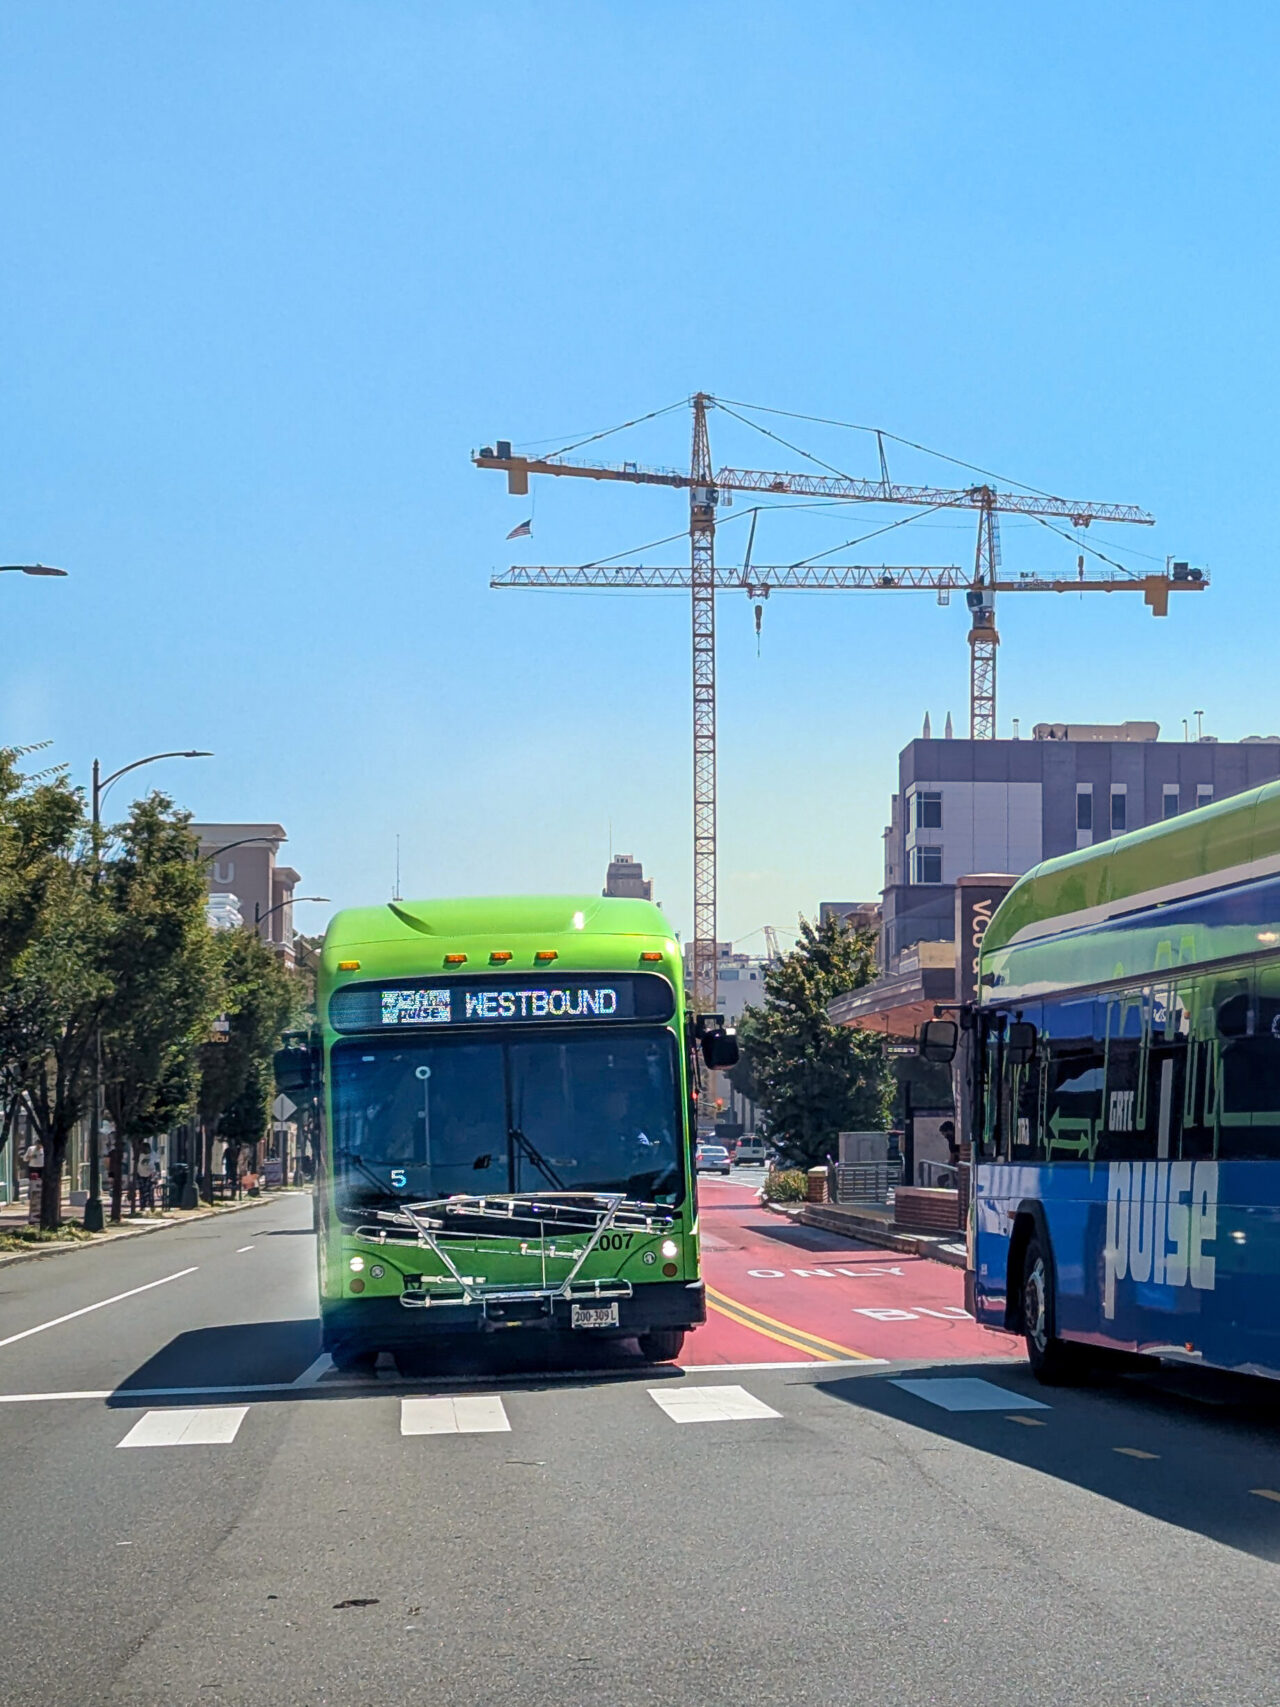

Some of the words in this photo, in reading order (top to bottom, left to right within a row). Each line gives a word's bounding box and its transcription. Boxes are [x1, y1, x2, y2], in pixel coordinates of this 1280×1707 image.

[465, 990, 616, 1018] WESTBOUND
[391, 1169, 407, 1188] 5
[1104, 1160, 1219, 1320] pulse
[746, 1266, 906, 1279] ONLY
[851, 1306, 977, 1322] BU
